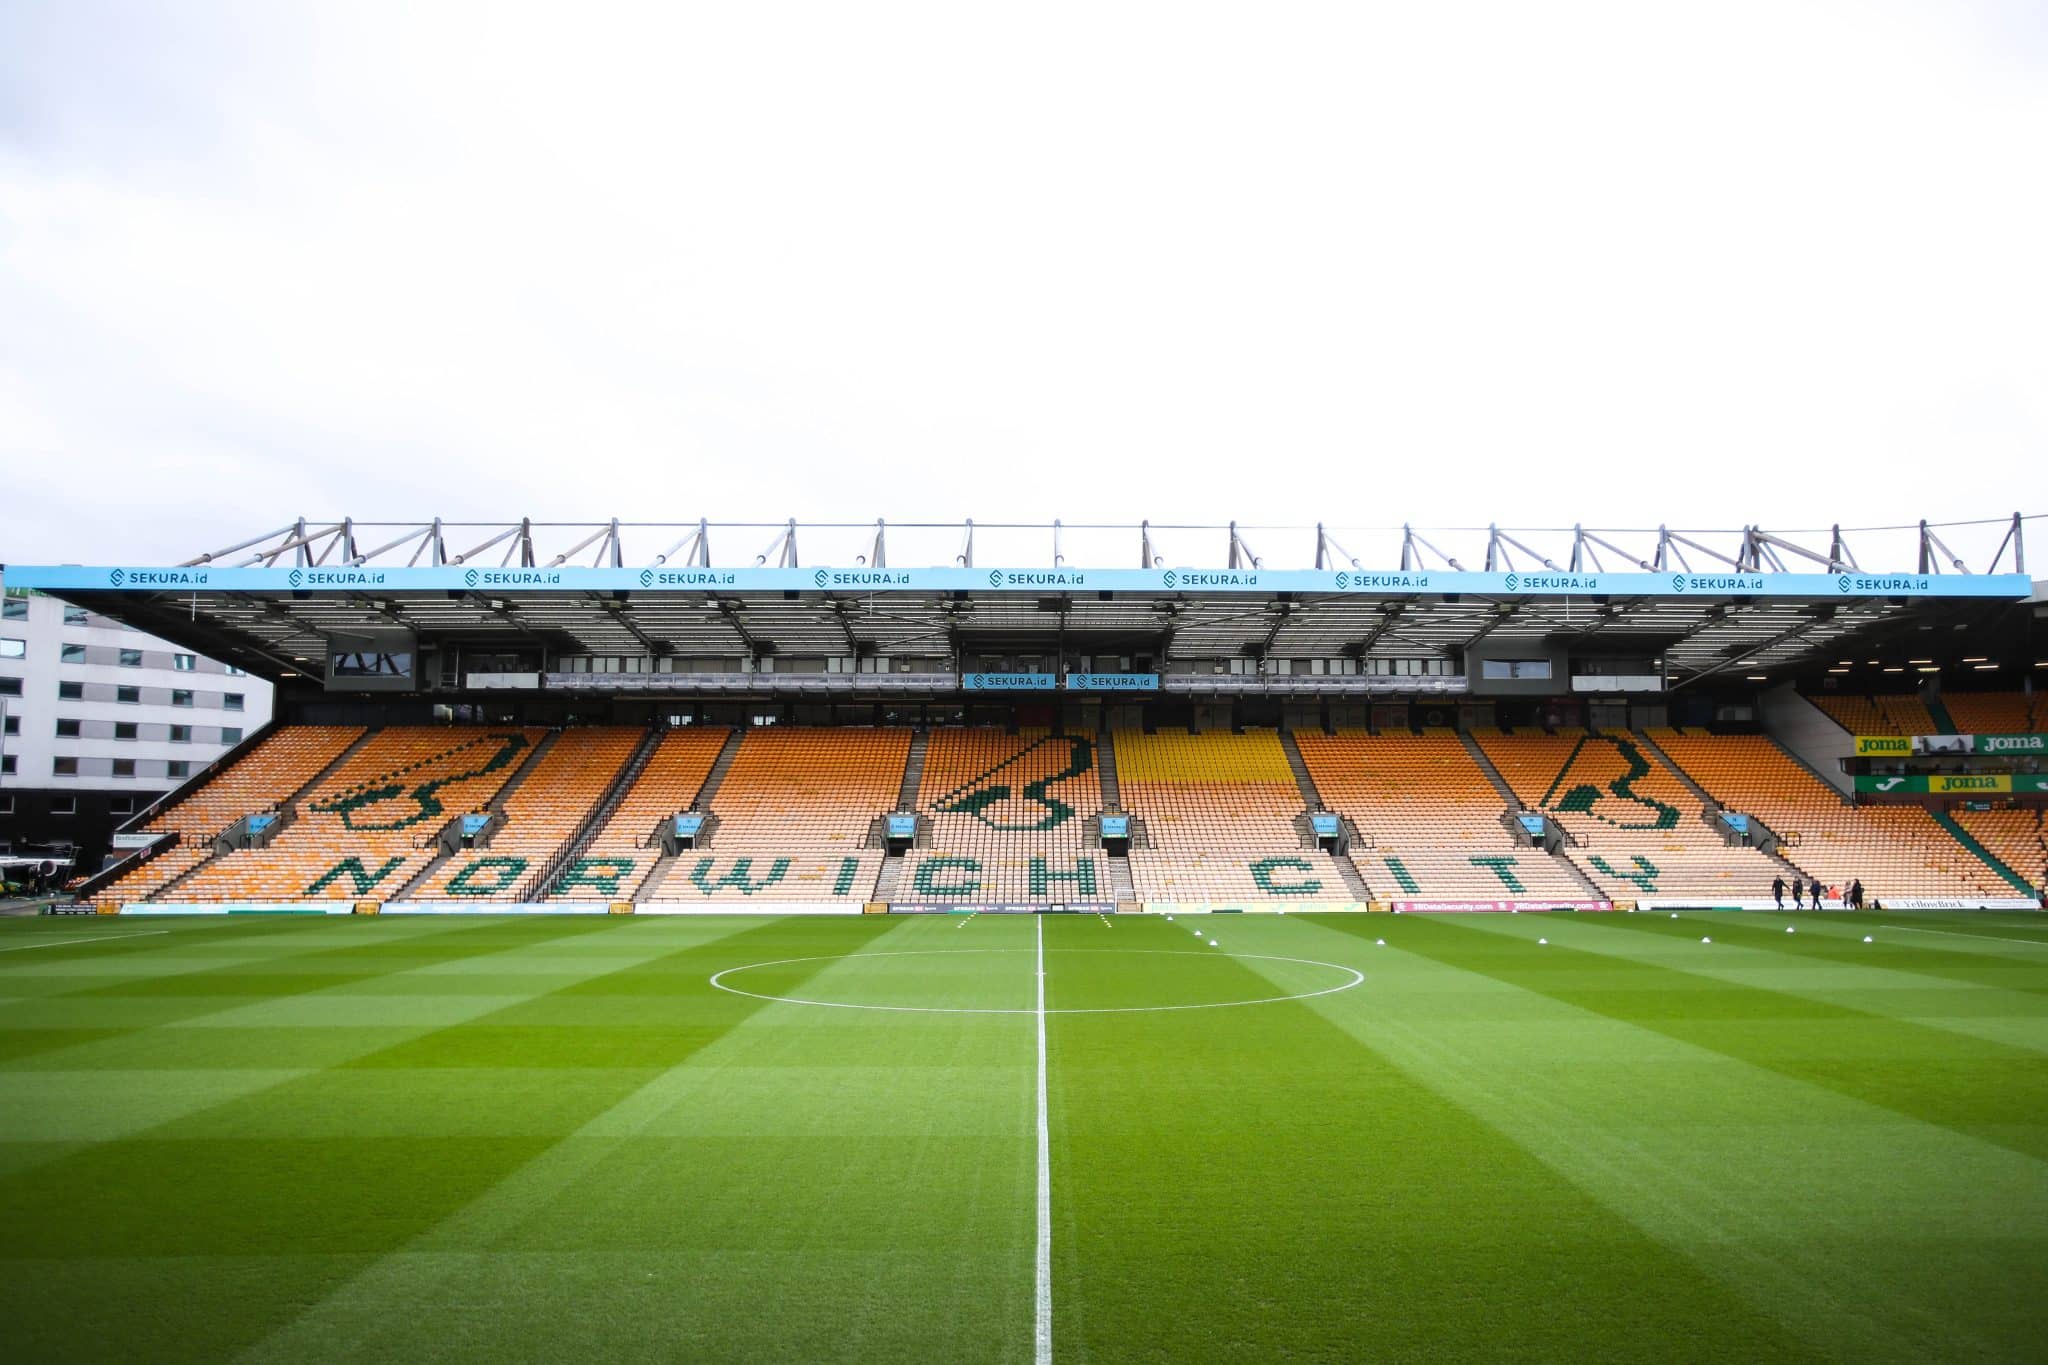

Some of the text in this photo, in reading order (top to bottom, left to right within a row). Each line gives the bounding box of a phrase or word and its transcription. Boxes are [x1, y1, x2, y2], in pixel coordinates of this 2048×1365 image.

[130, 573, 207, 583] SEKURA.id
[308, 574, 384, 583] SEKURA.id
[484, 574, 559, 583] SEKURA.id
[659, 574, 734, 583] SEKURA.id
[834, 574, 909, 583] SEKURA.id
[1009, 574, 1083, 584] SEKURA.id
[1183, 575, 1256, 584] SEKURA.id
[1355, 576, 1427, 586] SEKURA.id
[1524, 578, 1596, 588] SEKURA.id
[1691, 579, 1763, 589] SEKURA.id
[1856, 579, 1928, 590] SEKURA.id
[987, 677, 1047, 687] SEKURA.id
[1091, 677, 1150, 687] SEKURA.id
[302, 856, 1661, 896] NORWICH CITY
